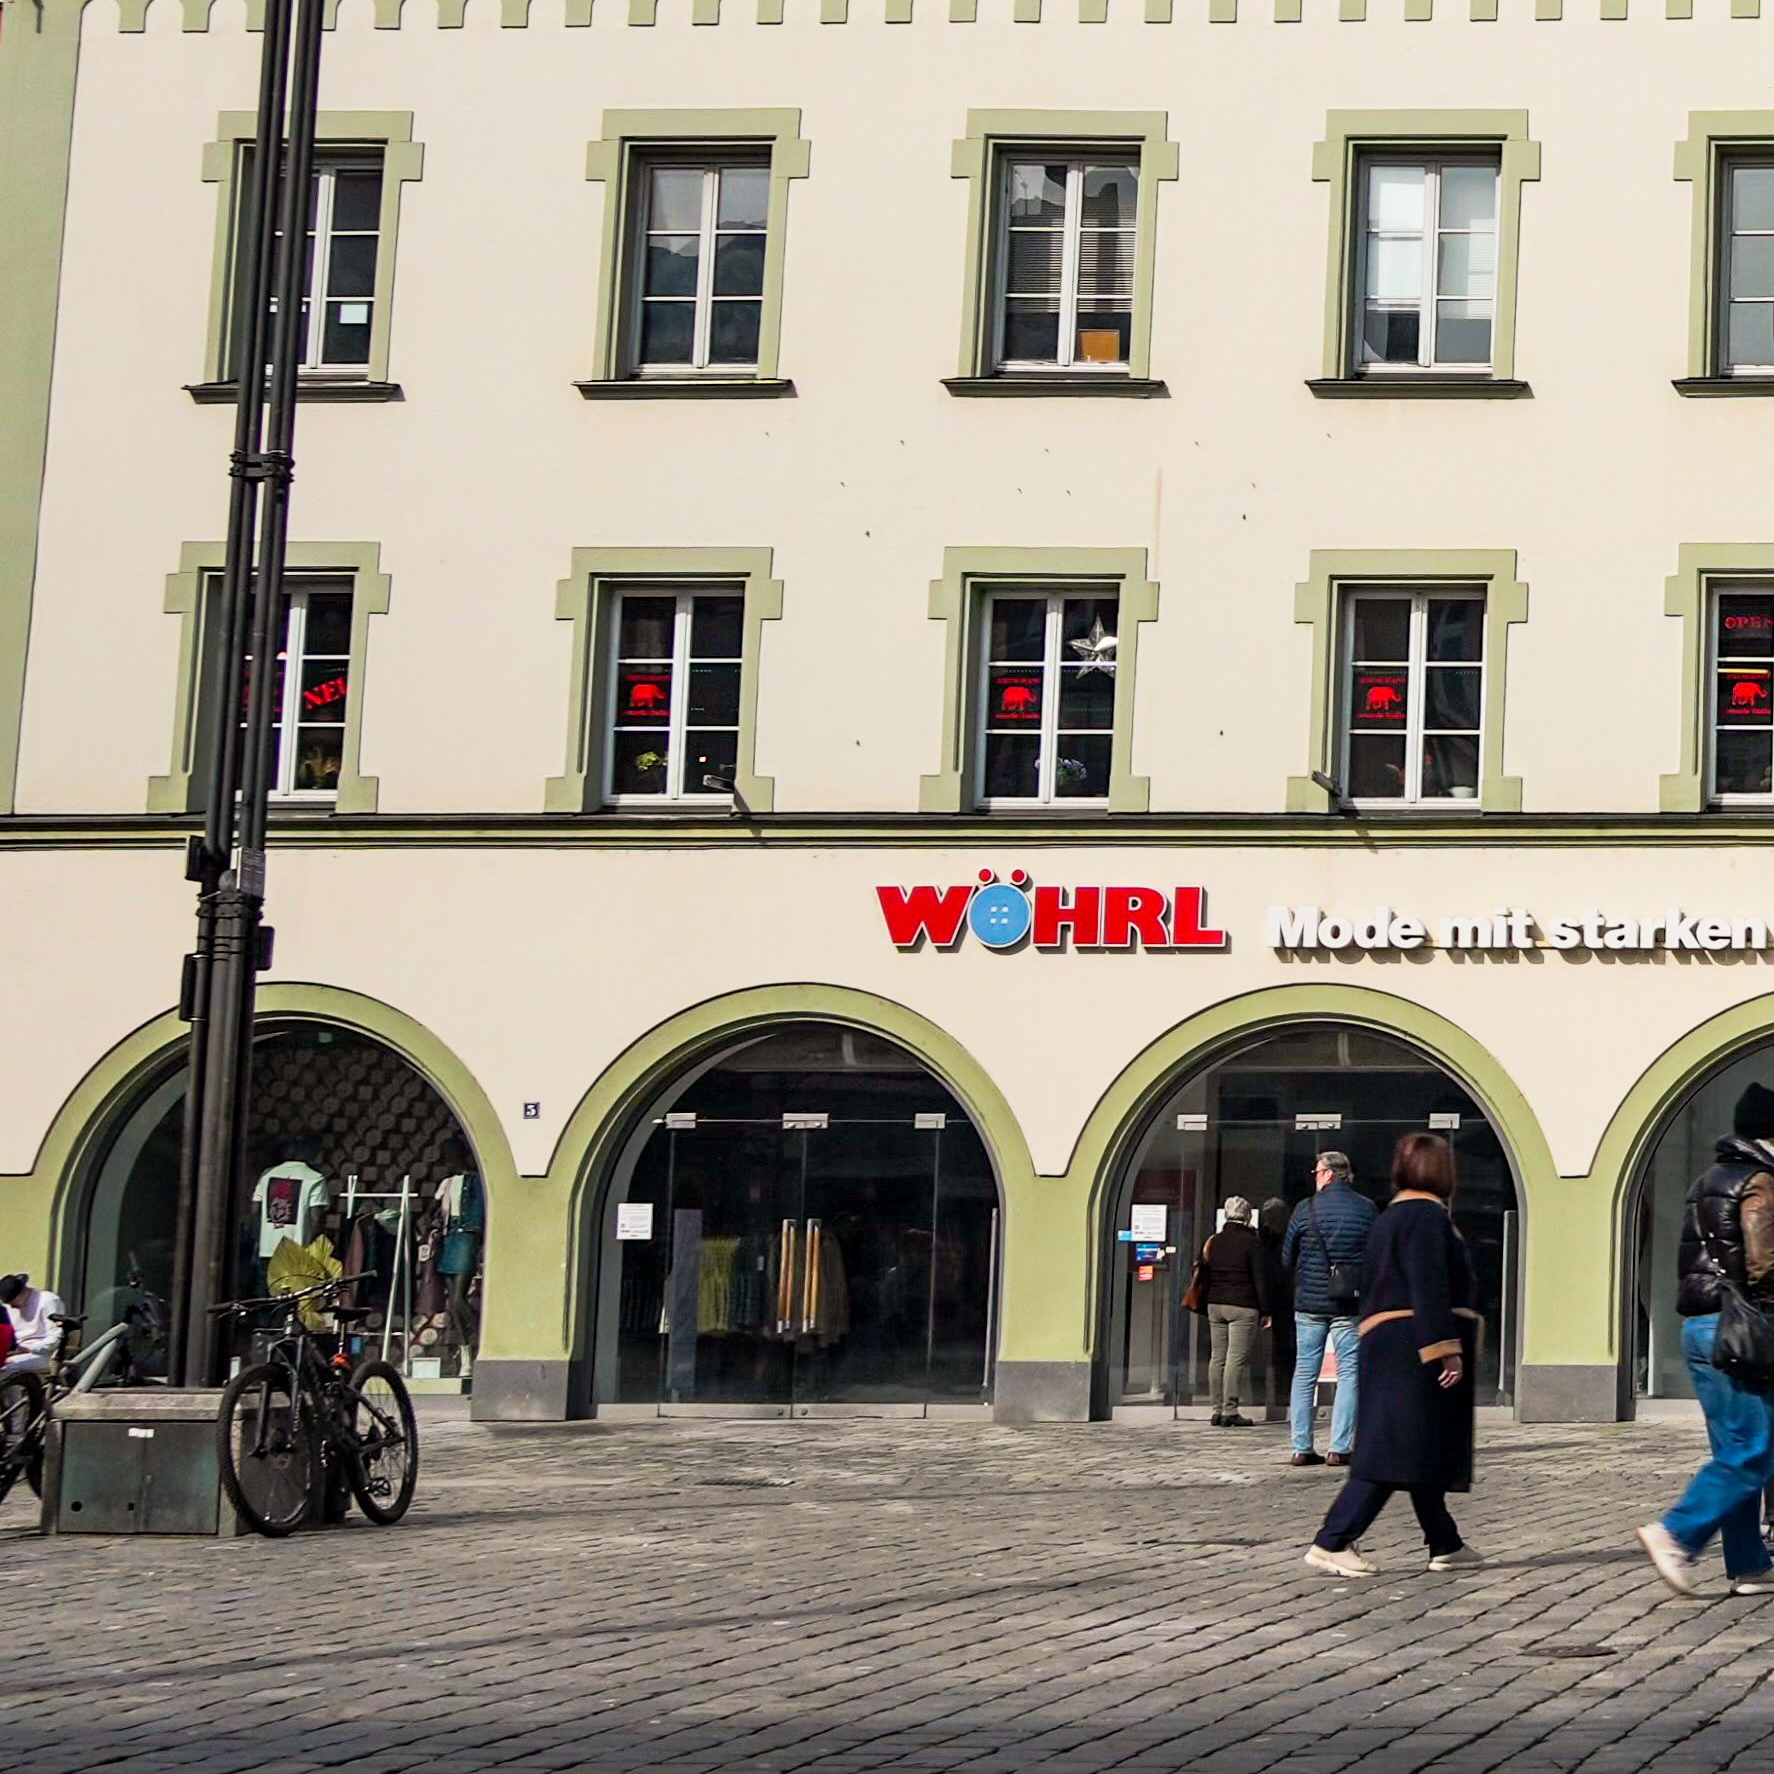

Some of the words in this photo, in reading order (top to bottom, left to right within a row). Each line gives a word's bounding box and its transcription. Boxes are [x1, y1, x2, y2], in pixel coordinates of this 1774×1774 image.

[875, 868, 1227, 948] WÖHRL
[1266, 906, 1426, 949] Mode
[1440, 907, 1535, 950] mit
[1548, 907, 1767, 950] starken
[526, 1104, 537, 1116] 5
